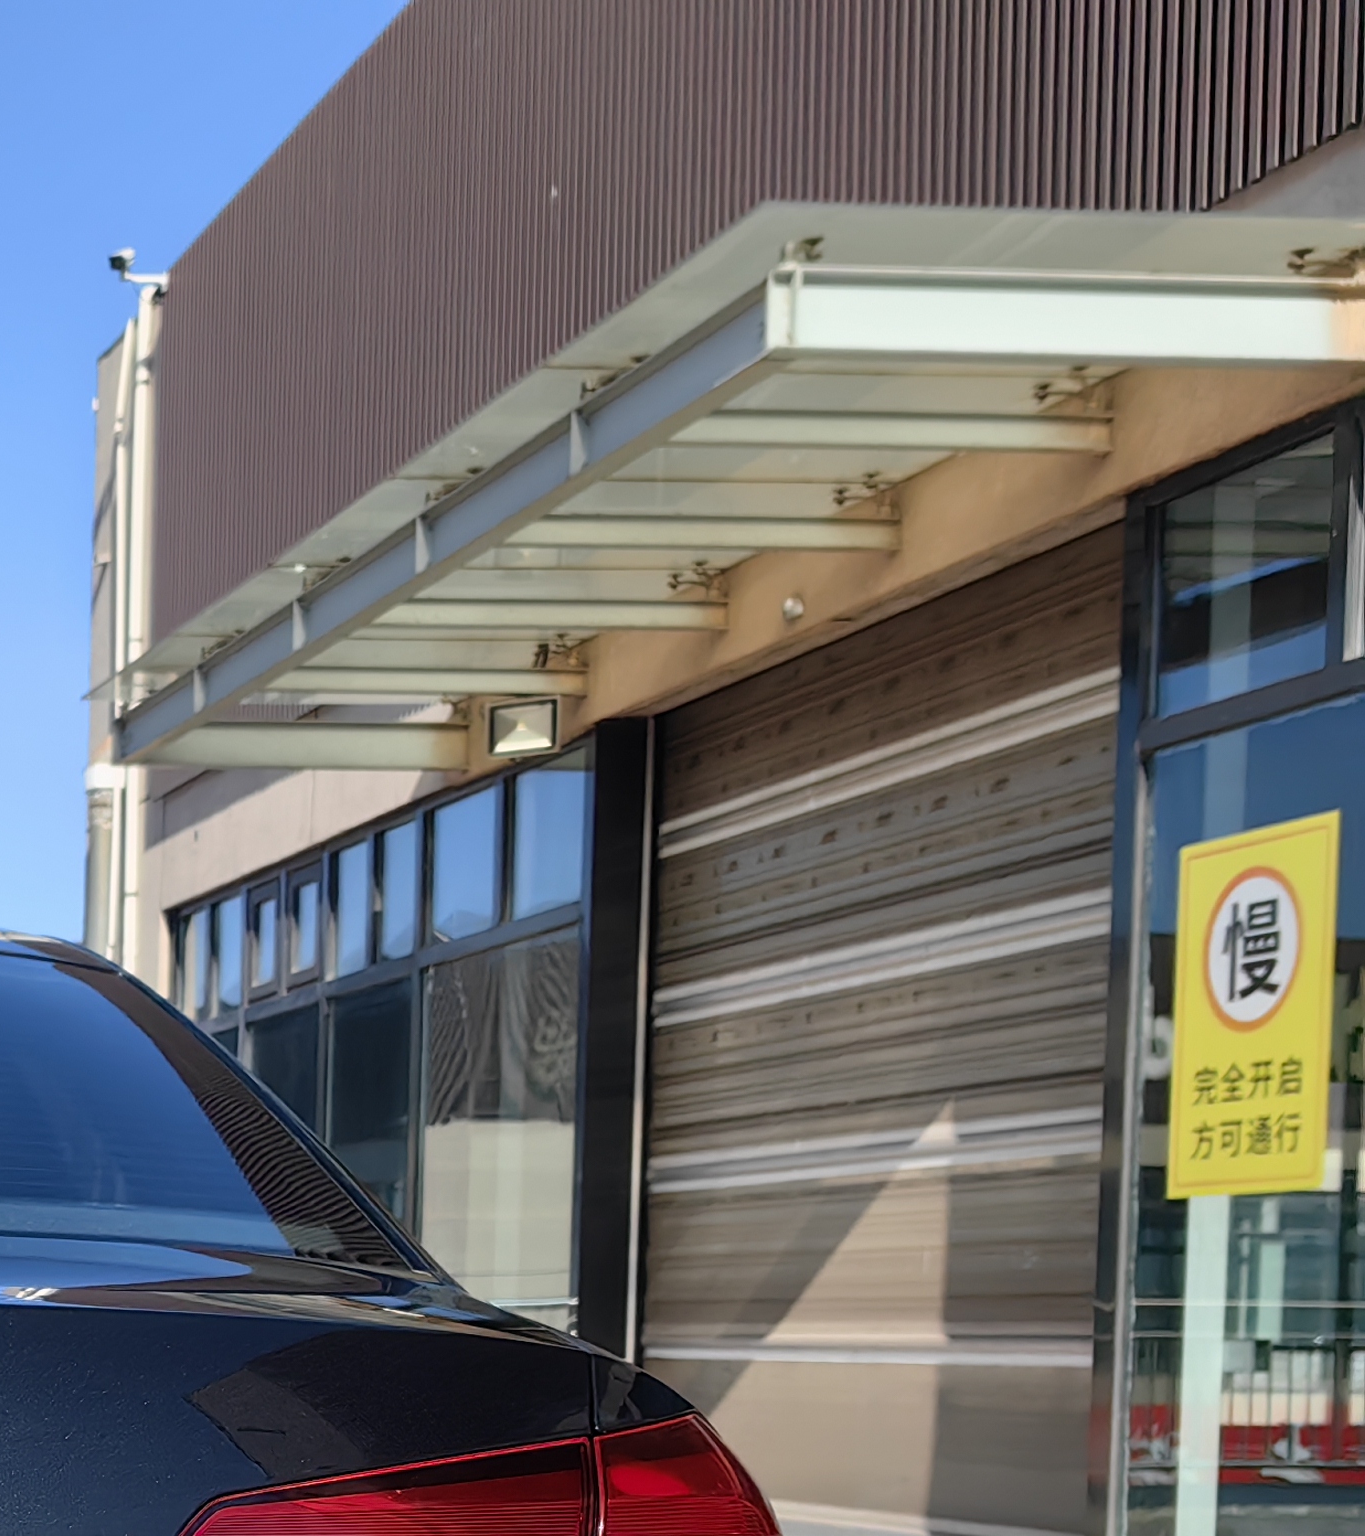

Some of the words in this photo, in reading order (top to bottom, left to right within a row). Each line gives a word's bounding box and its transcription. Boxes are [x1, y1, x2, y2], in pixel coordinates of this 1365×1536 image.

[1221, 899, 1279, 1001] 慢
[1192, 1055, 1303, 1106] 完全开启
[1190, 1113, 1302, 1160] 方可通行
